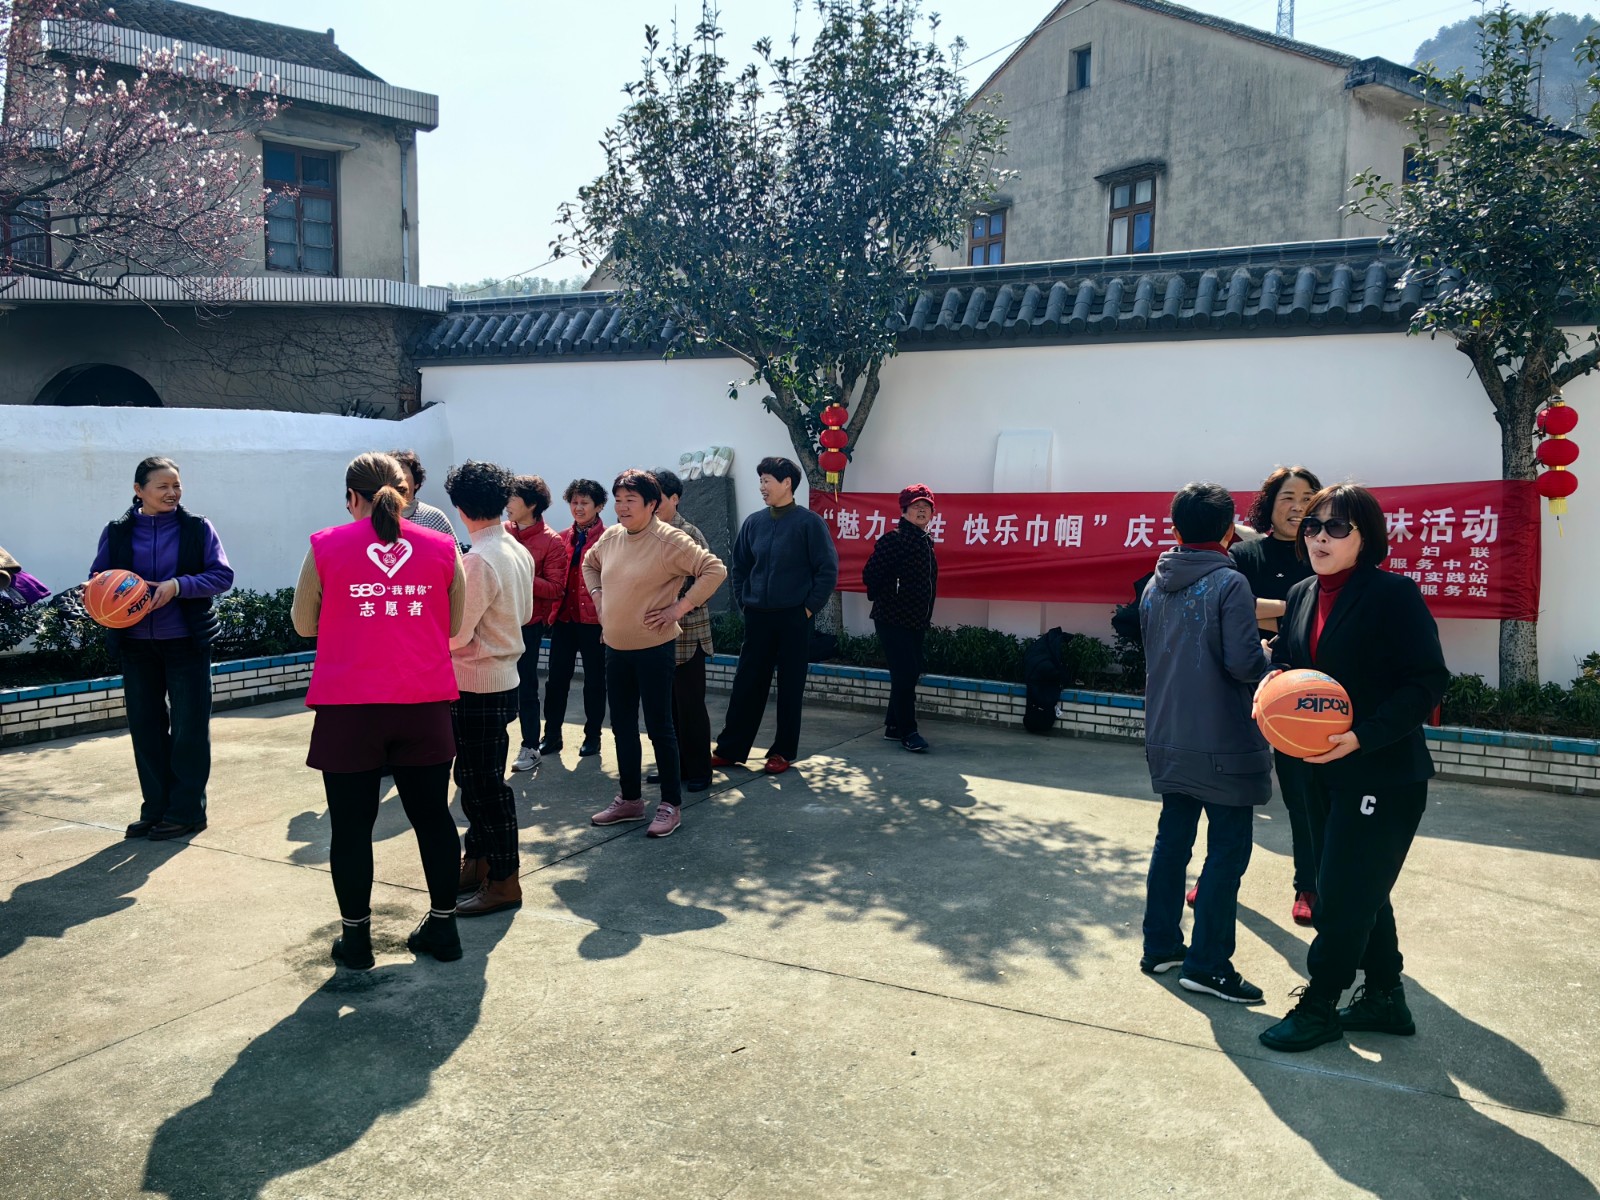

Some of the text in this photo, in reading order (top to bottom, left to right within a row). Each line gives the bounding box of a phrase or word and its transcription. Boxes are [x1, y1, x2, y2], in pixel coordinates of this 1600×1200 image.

[358, 600, 424, 618] 志愿者
[1359, 794, 1377, 816] C
